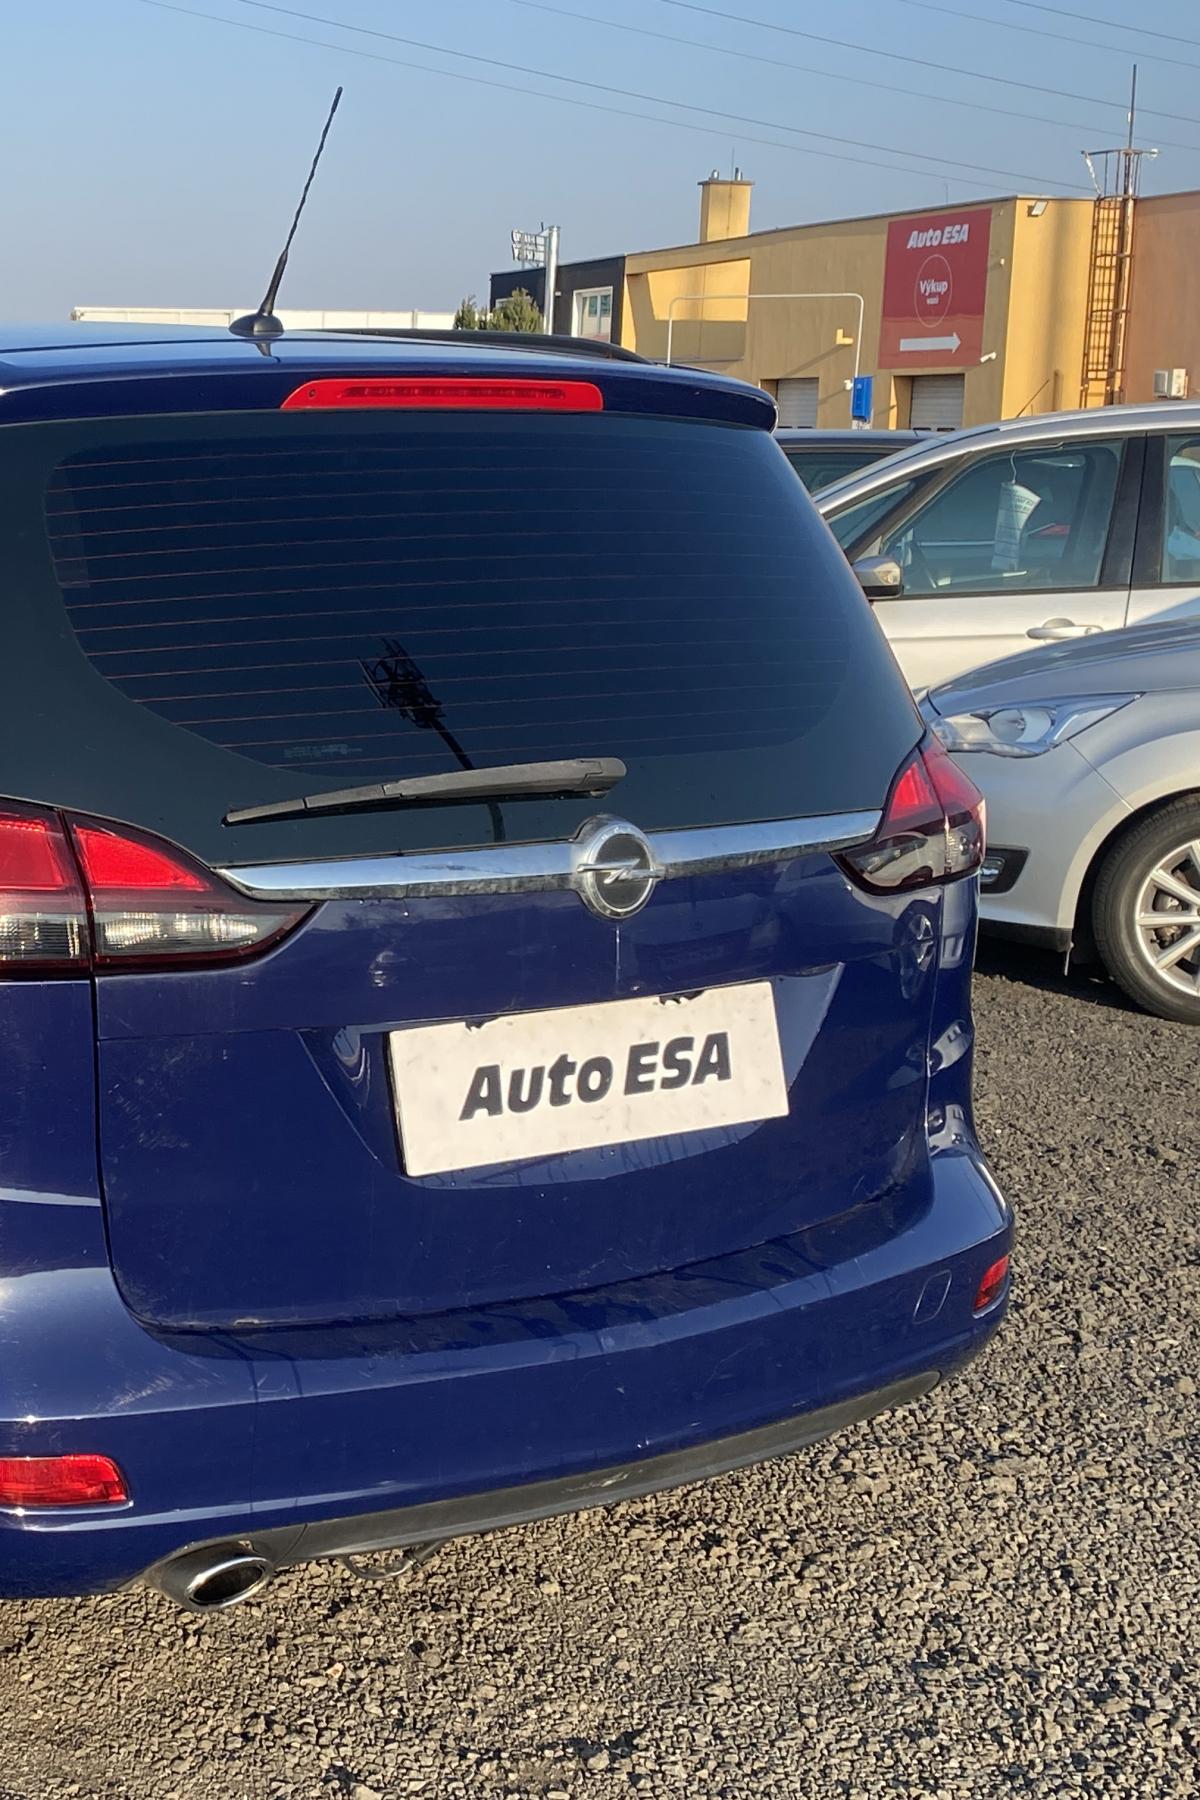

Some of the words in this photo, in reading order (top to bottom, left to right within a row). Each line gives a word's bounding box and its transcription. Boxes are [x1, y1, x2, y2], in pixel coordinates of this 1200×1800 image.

[907, 228, 942, 249] Auto
[941, 224, 969, 245] ESA
[919, 279, 948, 296] Výkup
[458, 1053, 613, 1121] Auto
[623, 1031, 731, 1096] ESA
